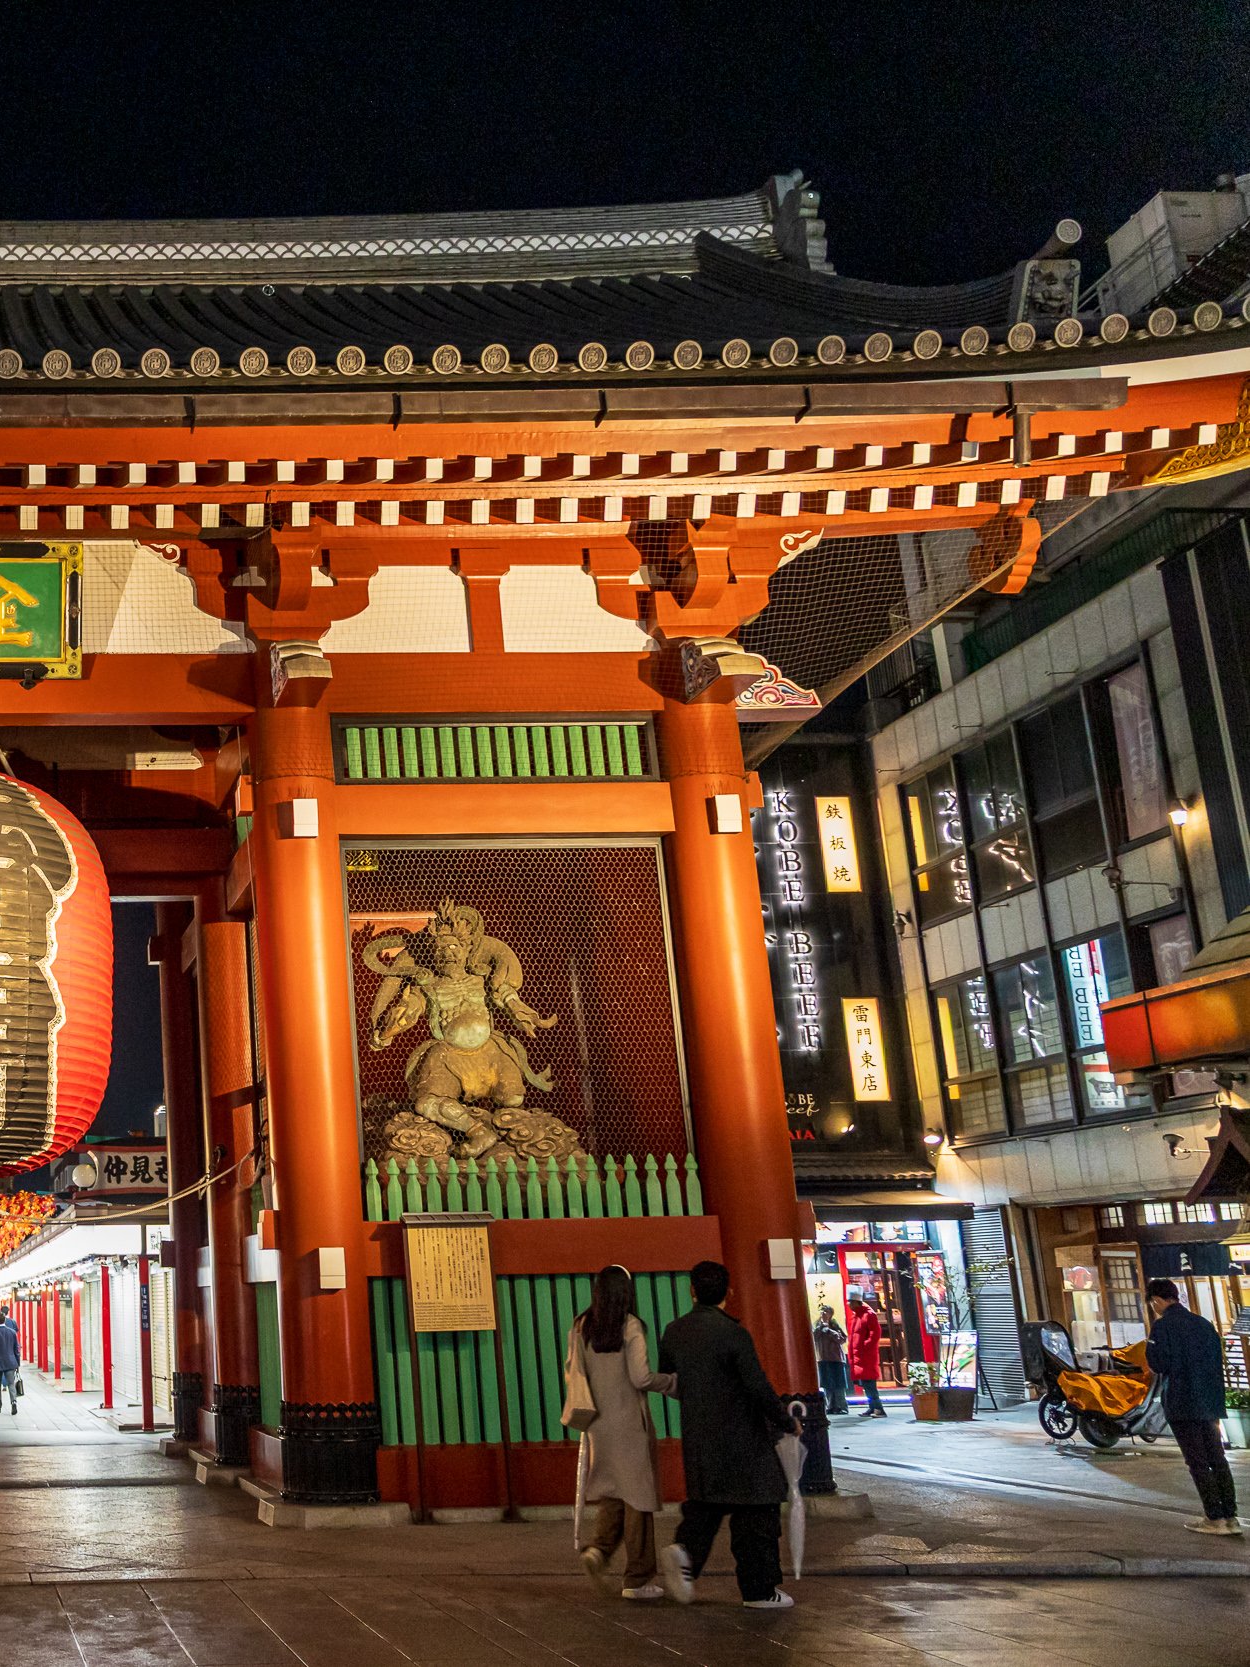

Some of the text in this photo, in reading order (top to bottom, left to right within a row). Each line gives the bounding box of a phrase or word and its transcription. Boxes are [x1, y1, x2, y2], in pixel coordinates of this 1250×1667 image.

[825, 804, 851, 882] 鉄板焼
[773, 790, 821, 1051] KOBE BEEF
[853, 1004, 878, 1092] 雷門東店
